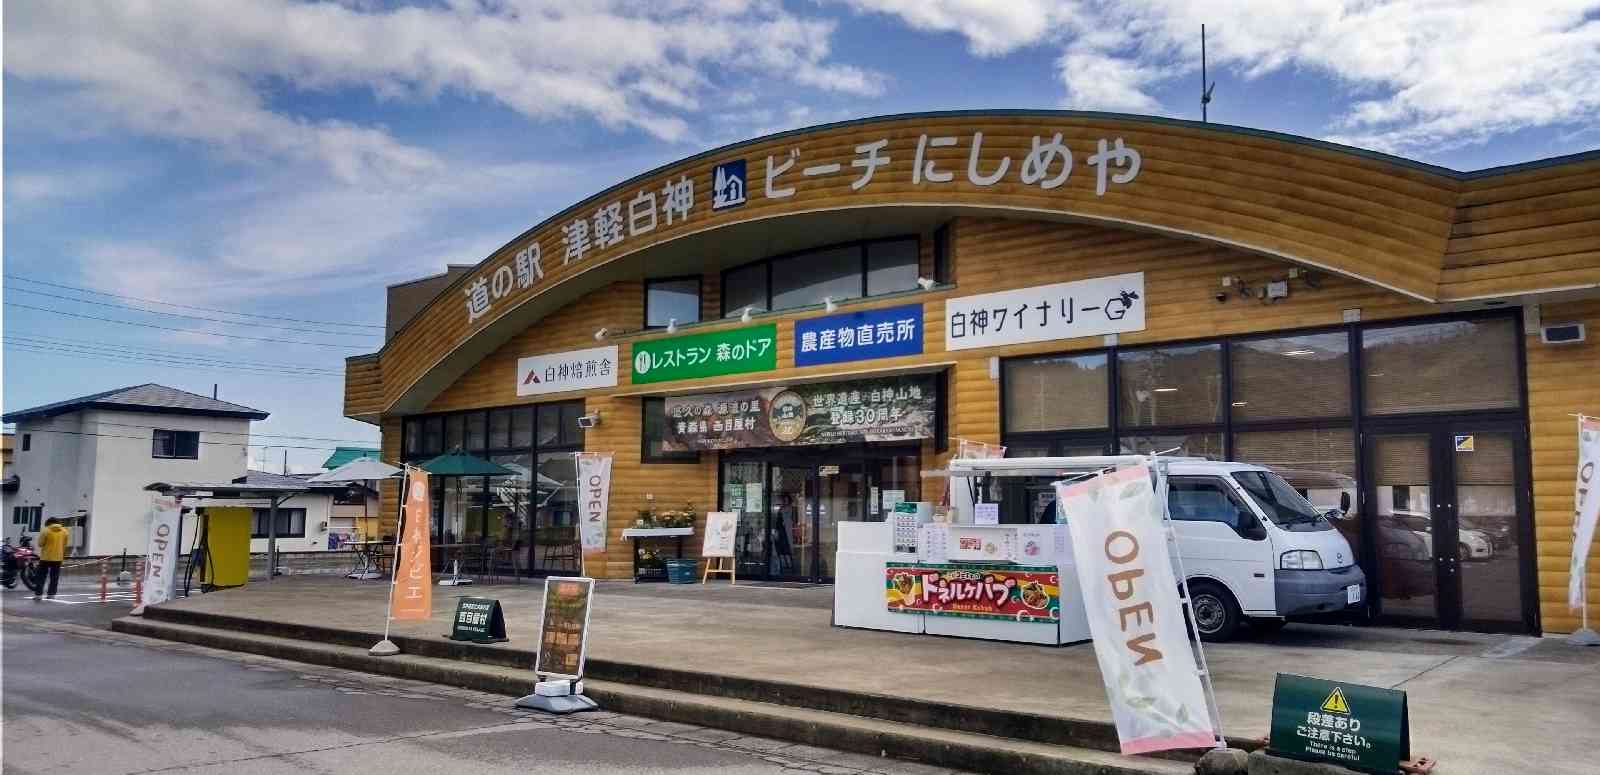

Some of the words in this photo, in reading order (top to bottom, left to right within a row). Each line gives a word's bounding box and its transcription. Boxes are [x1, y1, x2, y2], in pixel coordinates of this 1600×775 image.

[465, 242, 543, 323] 道の駅
[561, 175, 695, 265] 津軽白神
[951, 297, 1101, 338] 白神ワイナリー
[801, 317, 916, 353] 農産物直売所
[544, 358, 613, 383] 白神焙煎舎
[651, 346, 711, 370] レストラン
[716, 337, 772, 362] 森のドア
[830, 407, 902, 425] 登録30周年
[589, 474, 602, 523] OPEN
[152, 523, 170, 578] OPEN
[1296, 725, 1371, 749] ご注意下さい。
[1307, 711, 1361, 731] 段差あり
